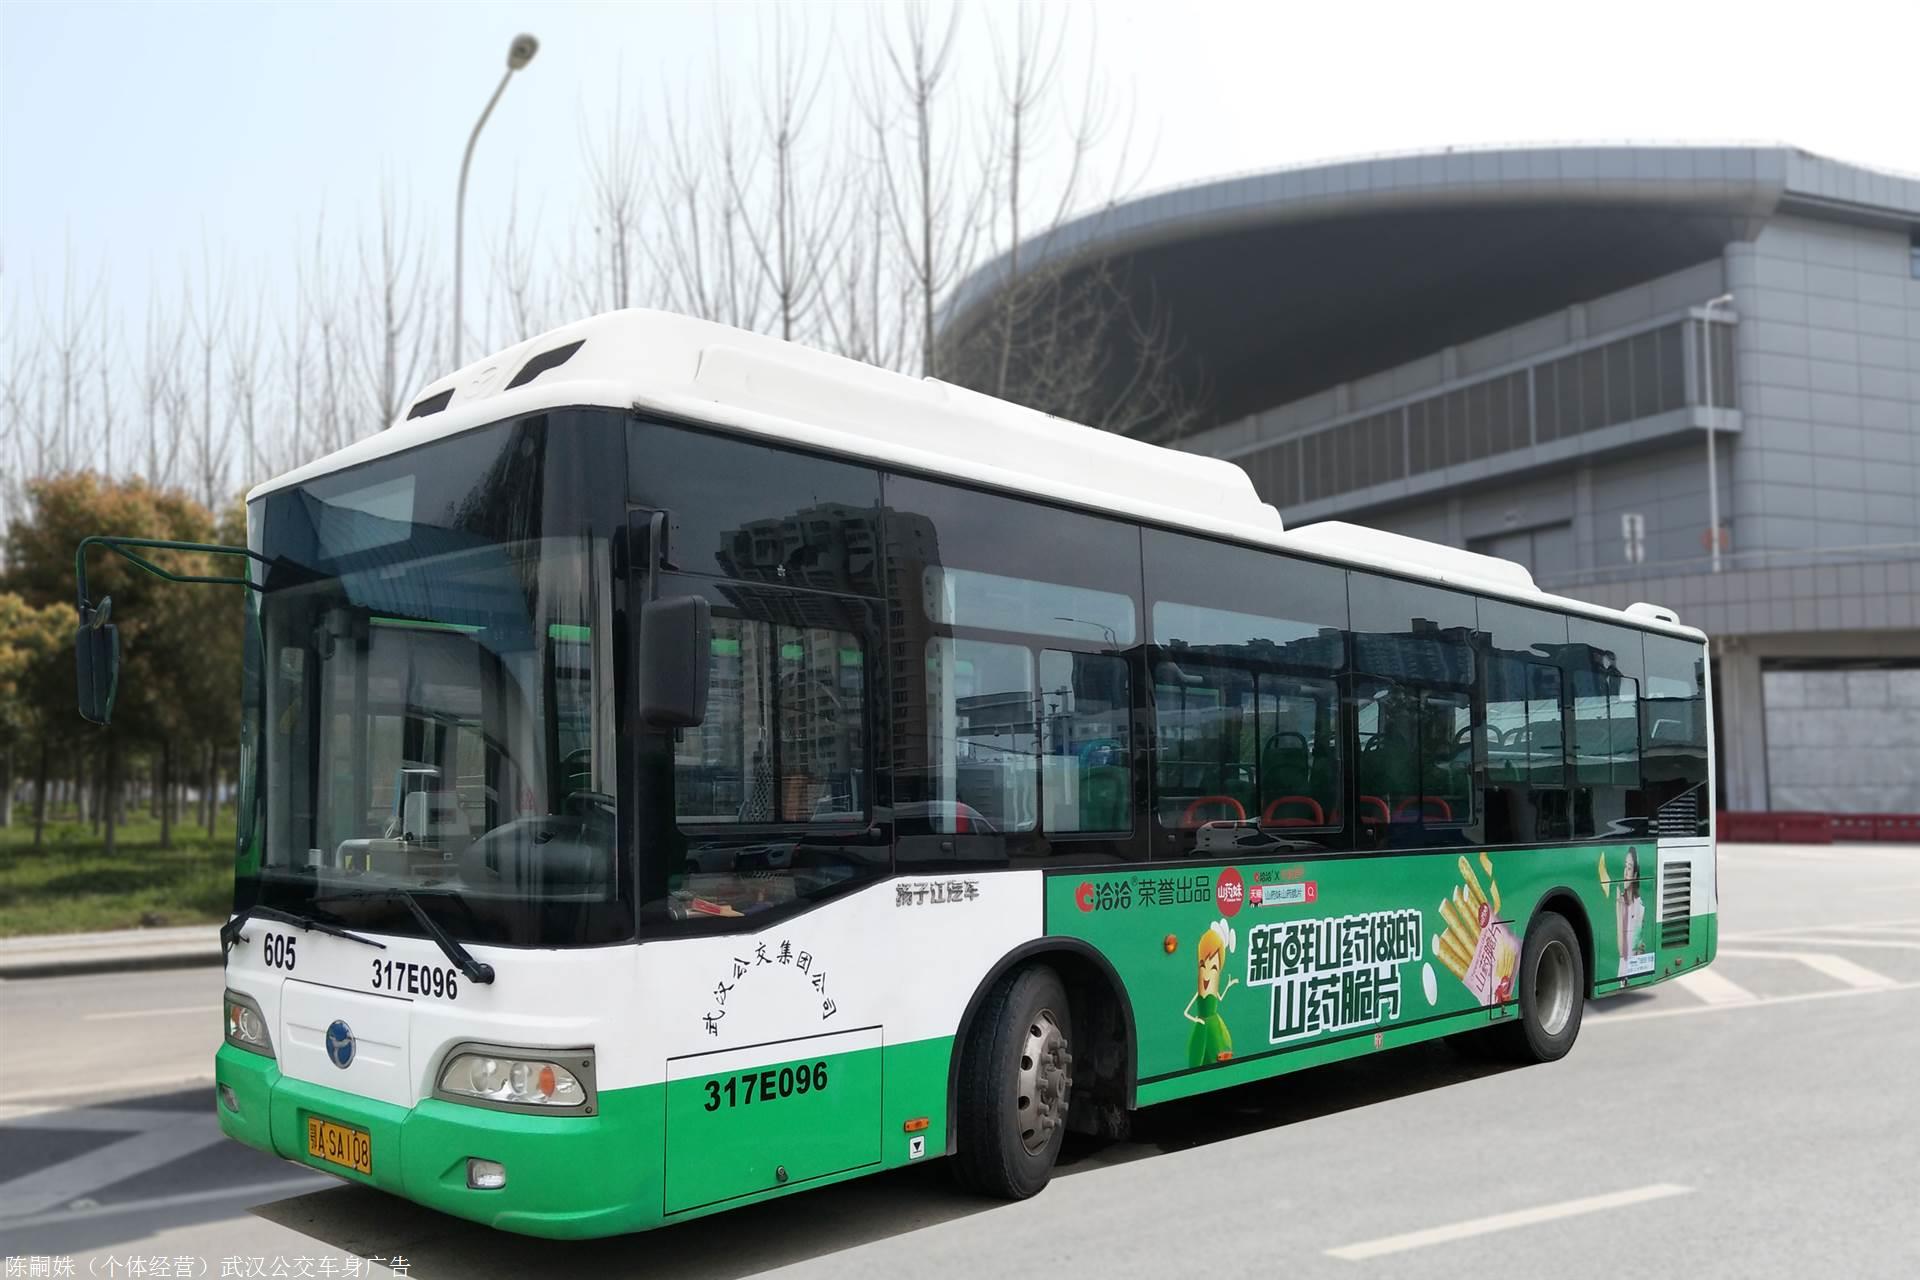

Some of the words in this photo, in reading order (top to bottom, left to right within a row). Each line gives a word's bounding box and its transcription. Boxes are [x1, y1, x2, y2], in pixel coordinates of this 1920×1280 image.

[263, 932, 297, 971] 605
[1249, 911, 1421, 983] 新鲜山药做的
[371, 959, 458, 1001] 317E096
[702, 939, 837, 1037] 武汉公交集团公司
[1271, 964, 1399, 1040] 山药脆片
[703, 1061, 828, 1112] 317E096
